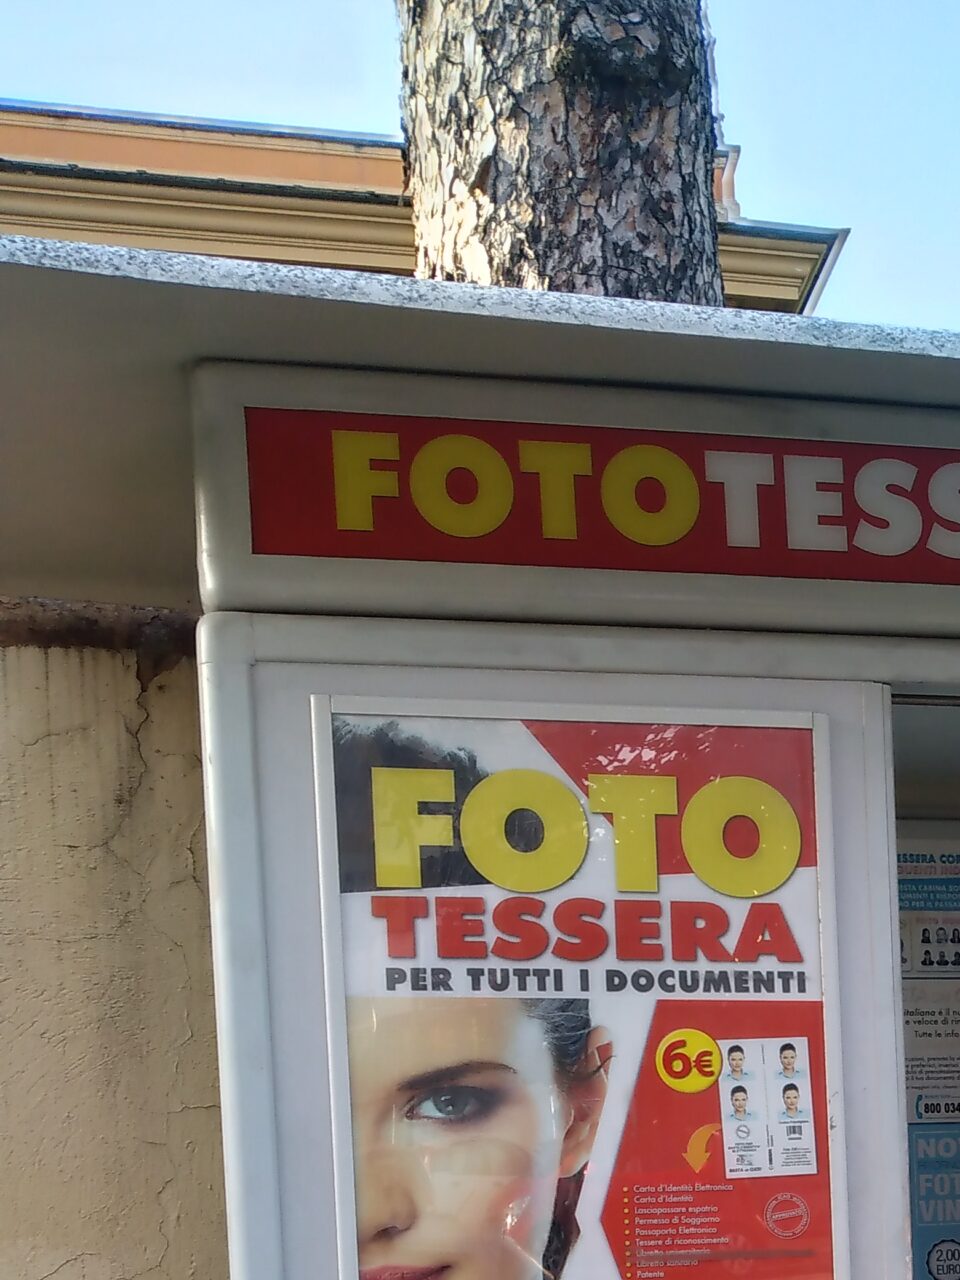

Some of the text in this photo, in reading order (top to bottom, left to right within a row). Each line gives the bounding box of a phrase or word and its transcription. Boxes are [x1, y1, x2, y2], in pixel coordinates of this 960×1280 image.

[371, 766, 802, 898] FOTO
[371, 896, 804, 963] TESSERA
[385, 967, 807, 994] PER TUTTI I DOCUMENTI
[913, 1017, 939, 1025] veloce
[941, 1017, 949, 1025] di
[934, 1030, 942, 1038] le
[944, 1029, 960, 1038] info
[663, 1040, 714, 1079] 6€
[924, 1103, 941, 1114] 800
[634, 1185, 656, 1193] Carta
[694, 1183, 734, 1192] Elettronica
[634, 1205, 719, 1215] Lasciapassare espatrio
[635, 1216, 720, 1225] Permesso di Soggiorno
[635, 1226, 717, 1237] Passaporto Elettronico
[636, 1236, 729, 1247] Tessere di riconoscimento
[936, 1248, 960, 1264] 2,00
[637, 1271, 665, 1279] Patente
